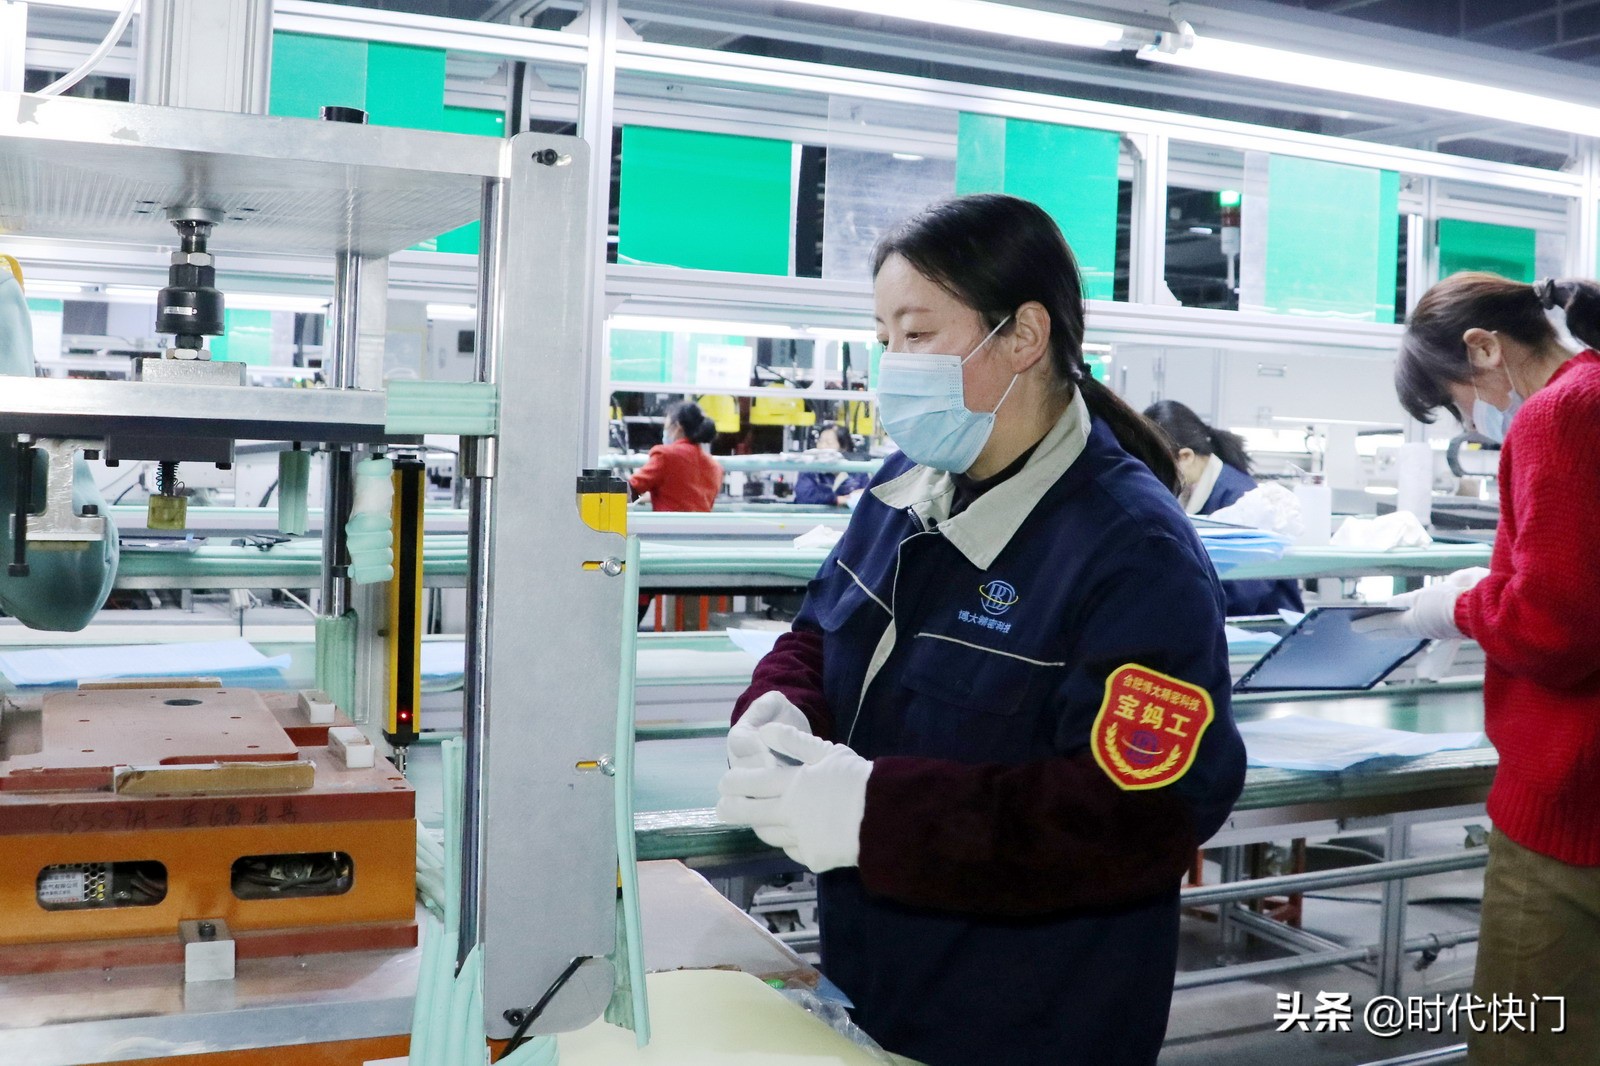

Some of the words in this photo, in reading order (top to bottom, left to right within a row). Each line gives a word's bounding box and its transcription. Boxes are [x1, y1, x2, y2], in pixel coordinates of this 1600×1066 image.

[958, 609, 1012, 634] 博大精密科技
[1122, 674, 1201, 712] 合肥博大精密科技
[1113, 694, 1192, 738] 宝妈工
